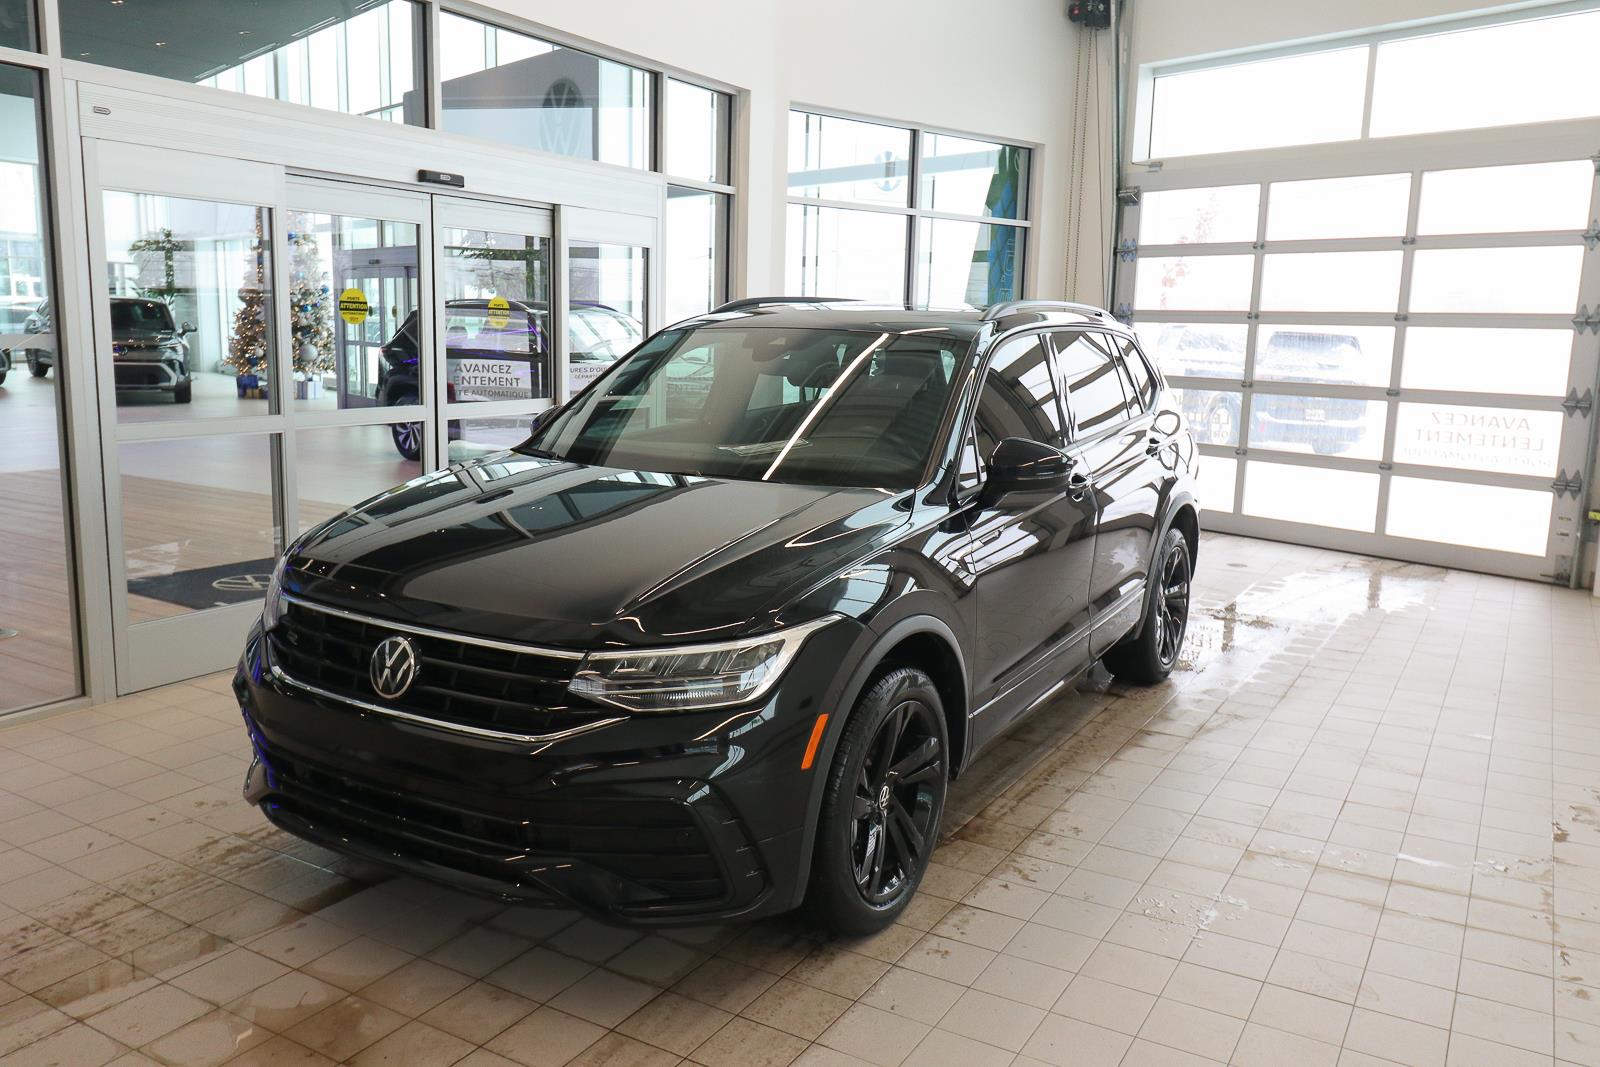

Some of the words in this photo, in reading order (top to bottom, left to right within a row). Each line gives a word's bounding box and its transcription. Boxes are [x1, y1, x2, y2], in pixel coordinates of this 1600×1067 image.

[454, 363, 512, 375] AVANCEZ
[453, 375, 521, 387] ENTEMENT
[471, 389, 529, 399] AUTOMATIQUE
